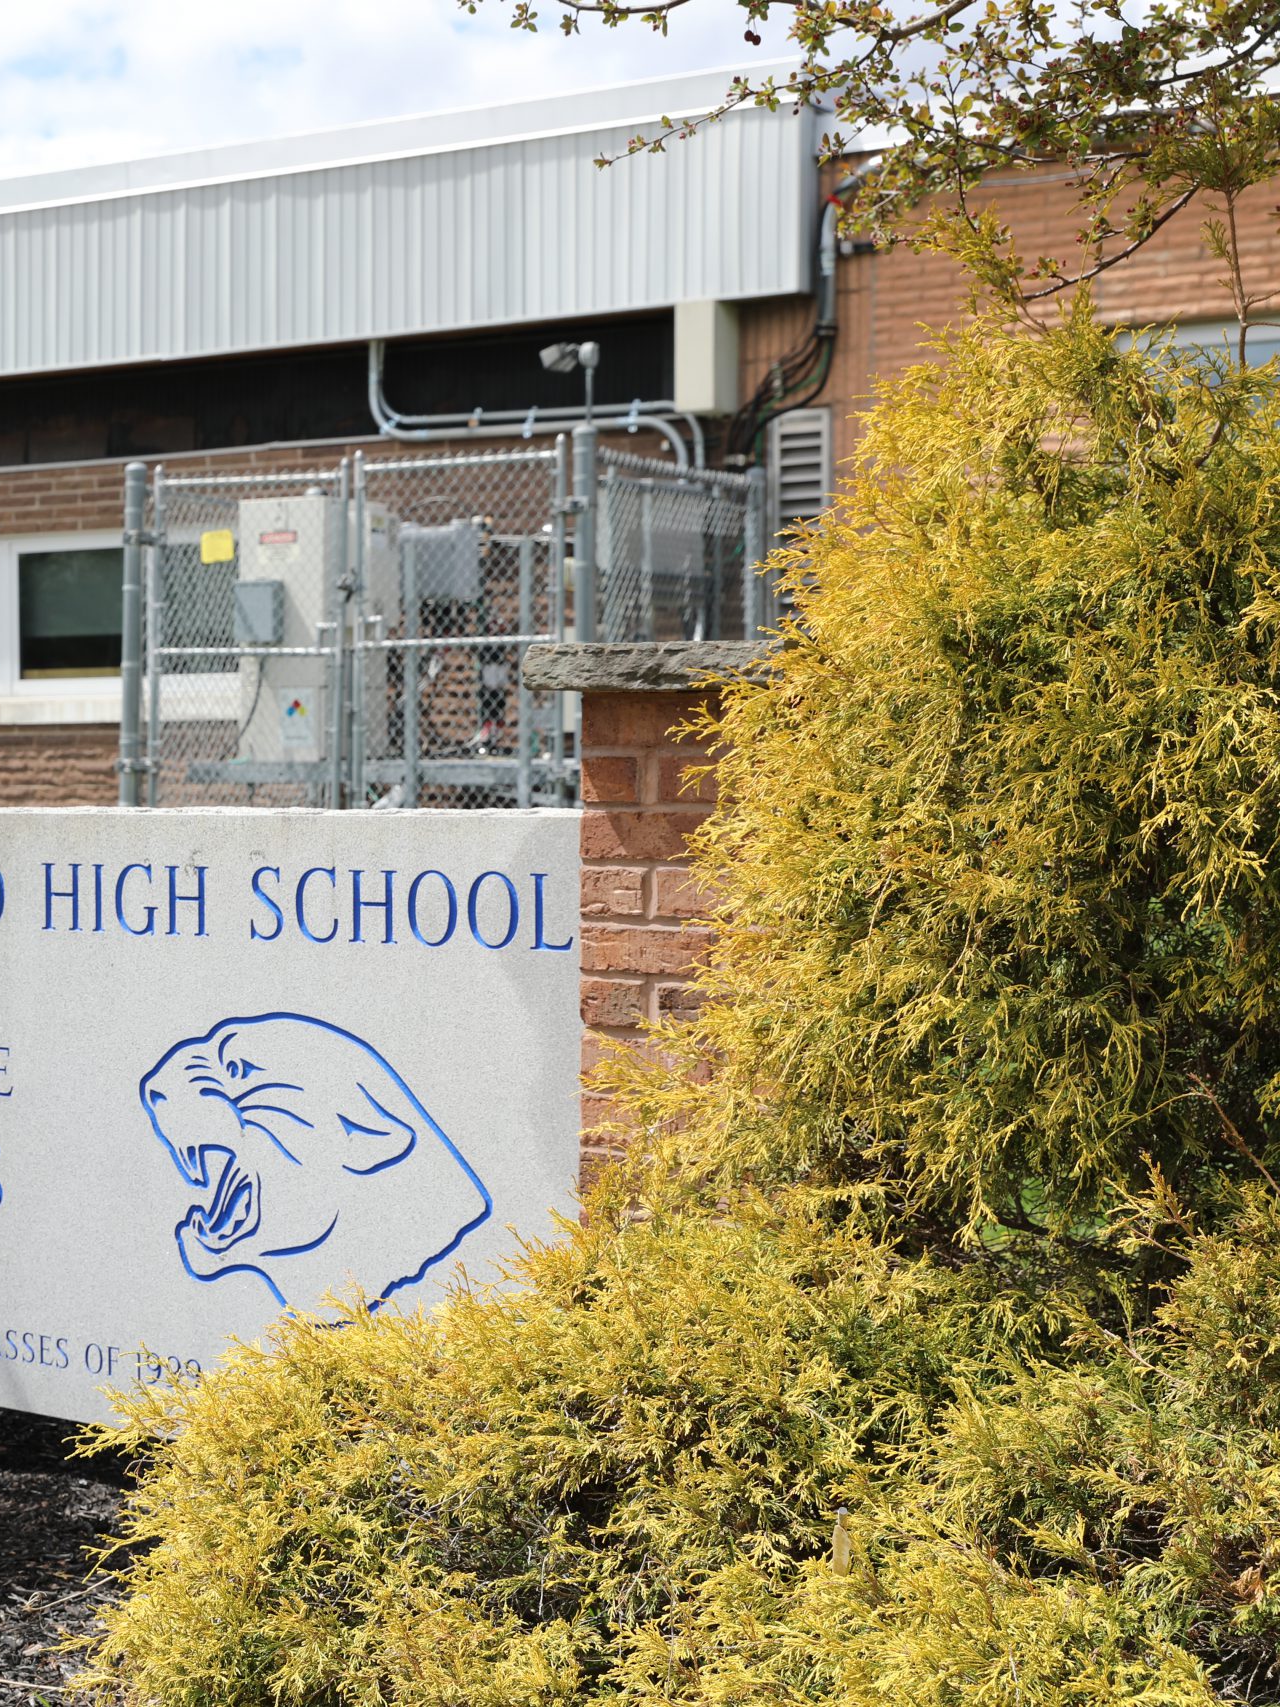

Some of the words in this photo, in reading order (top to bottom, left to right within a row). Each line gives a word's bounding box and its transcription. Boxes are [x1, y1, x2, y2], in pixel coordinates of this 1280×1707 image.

[41, 863, 209, 937] HIGH
[250, 866, 574, 951] SCHOOL
[84, 1343, 120, 1376] OF
